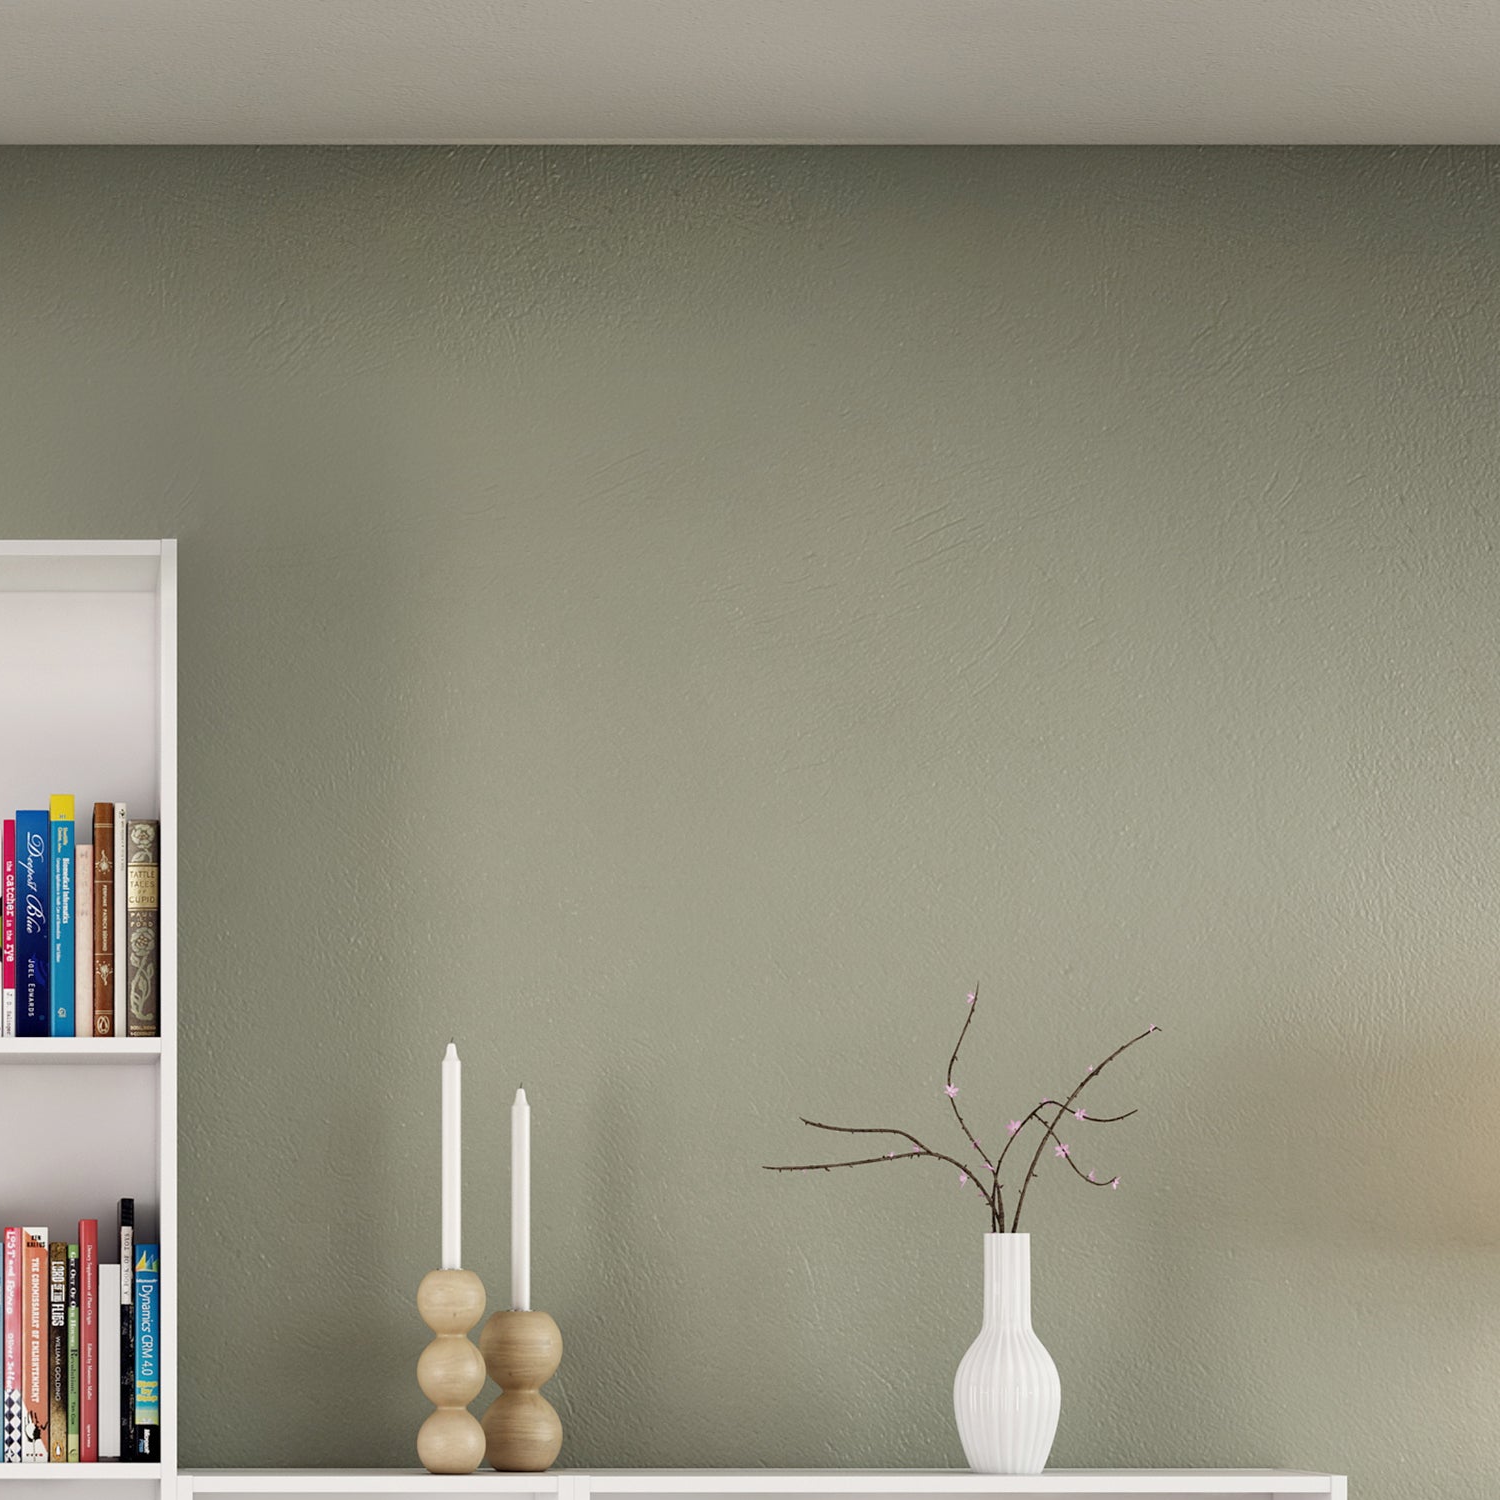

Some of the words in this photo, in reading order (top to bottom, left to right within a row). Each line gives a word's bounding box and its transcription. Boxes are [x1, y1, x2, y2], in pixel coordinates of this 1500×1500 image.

[18, 832, 45, 891] Deepest
[130, 880, 155, 888] TALES
[6, 874, 15, 917] catcher
[129, 896, 155, 904] CUPID
[6, 920, 13, 928] in
[26, 894, 45, 934] Blue
[3, 944, 15, 962] rye
[27, 959, 35, 979] JOEL
[27, 983, 35, 1017] EDWARDS
[52, 1261, 64, 1282] LORD
[139, 1285, 153, 1332] Dynamics
[32, 1330, 39, 1339] OF
[142, 1335, 153, 1358] CRM
[142, 1360, 153, 1376] 4.0
